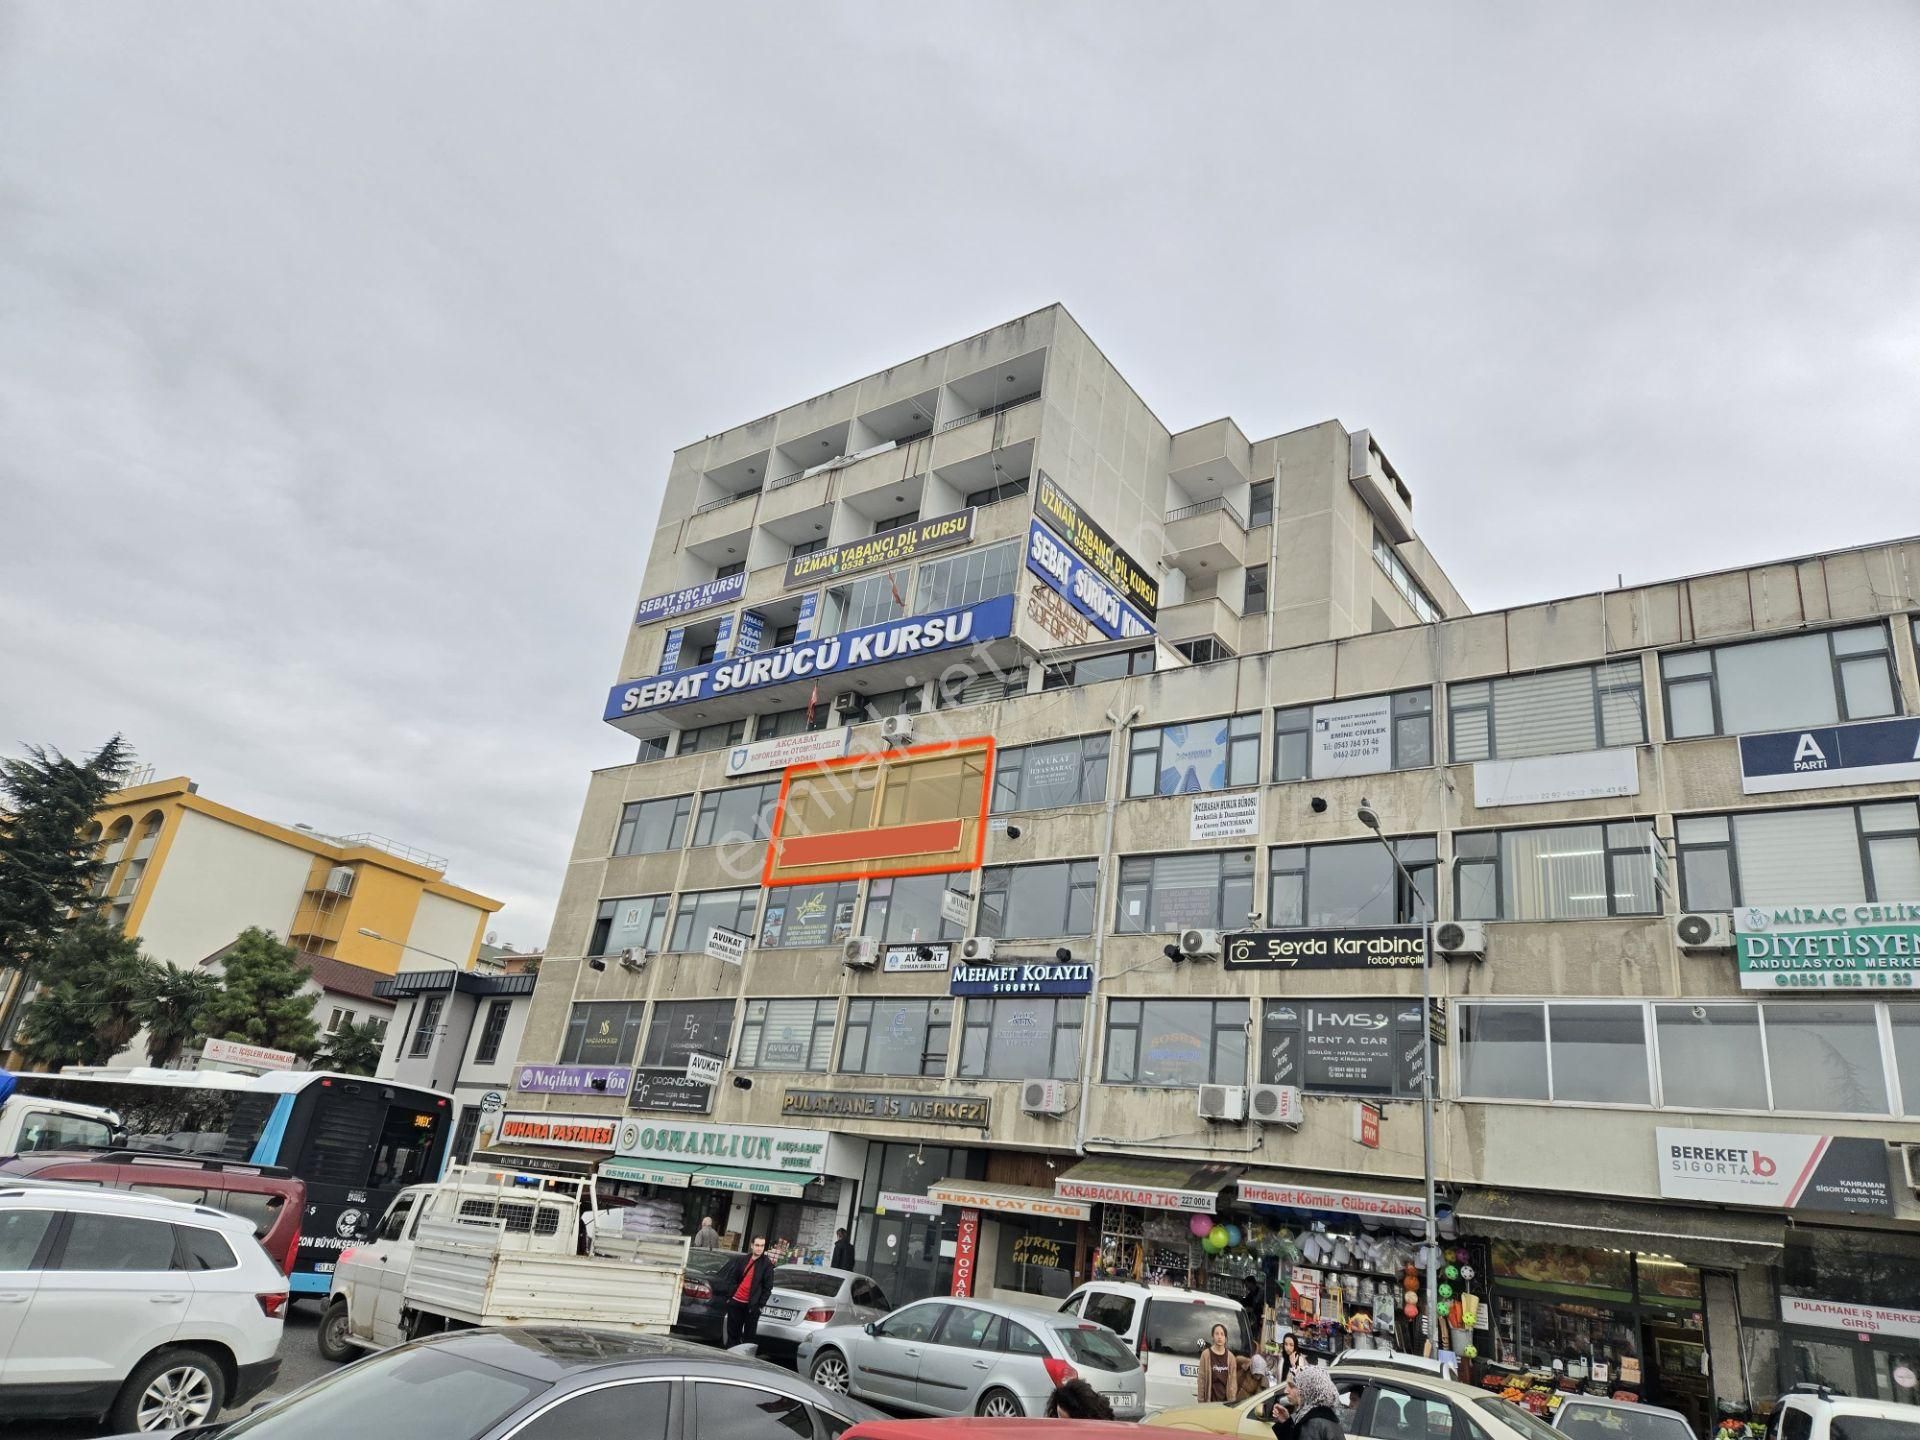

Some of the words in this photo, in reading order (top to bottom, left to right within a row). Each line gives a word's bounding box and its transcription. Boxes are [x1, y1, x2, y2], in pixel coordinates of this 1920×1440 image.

[794, 552, 837, 577] UZMAN
[840, 536, 894, 563] YABANCI
[897, 527, 918, 547] DİL
[921, 516, 968, 541] KURSU
[1041, 485, 1075, 530] UZMAN
[1077, 517, 1114, 563] YABANCI
[1115, 556, 1128, 583] DİL
[1129, 568, 1157, 607] KURSU
[841, 556, 865, 571] 0538
[867, 552, 885, 565] 302
[887, 548, 900, 559] 00
[902, 545, 915, 556] 26
[1031, 530, 1072, 586] SEBAT
[1074, 567, 1120, 629] SÜRÜCÜ
[639, 594, 675, 614] SEBAT
[678, 587, 700, 604] SRC
[702, 574, 744, 597] KURSU
[663, 605, 682, 616] 228
[684, 602, 691, 611] 0
[693, 596, 713, 608] 228
[621, 671, 708, 714] SEBAT
[712, 632, 841, 693] SÜRÜCÜ
[847, 611, 973, 665] KURSU
[775, 734, 819, 749] AKÇAABAT
[1331, 731, 1353, 739] EMİNE
[1794, 733, 1826, 762] A
[1773, 906, 1847, 926] MİRAÇ
[1854, 902, 1920, 925] ÇELİK
[712, 931, 742, 947] AVUKAT
[1268, 938, 1327, 958] Şeyda
[1749, 958, 1856, 969] ANDULASYON
[952, 965, 1018, 982] MEHMET
[1022, 964, 1088, 981] KOLAYLI
[1892, 973, 1912, 986] 33
[1308, 1036, 1342, 1044] RENT
[692, 1056, 721, 1073] AVUKAT
[783, 1096, 875, 1114] PULATHANE
[503, 1120, 549, 1139] BUHARA
[551, 1123, 616, 1144] PASTANESİ
[1671, 1146, 1748, 1162] BEREKET
[605, 1168, 645, 1181] OSMANLI
[704, 1177, 743, 1190] OSMANLI
[1060, 1185, 1153, 1205] KARABACAKLAR
[1156, 1193, 1180, 1208] TİC.
[1181, 1195, 1193, 1205] 227
[1816, 1184, 1850, 1194] SİGORTA
[937, 1193, 991, 1206] DURAK
[996, 1200, 1026, 1211] ÇAY
[1032, 1203, 1081, 1217] OCAĞI
[961, 1210, 979, 1222] DURAK
[1014, 1236, 1061, 1256] DURAK
[1031, 1252, 1060, 1268] OCAĞI
[1793, 1301, 1859, 1317] PULATHANE
[1841, 1318, 1880, 1331] GİRİŞİ
